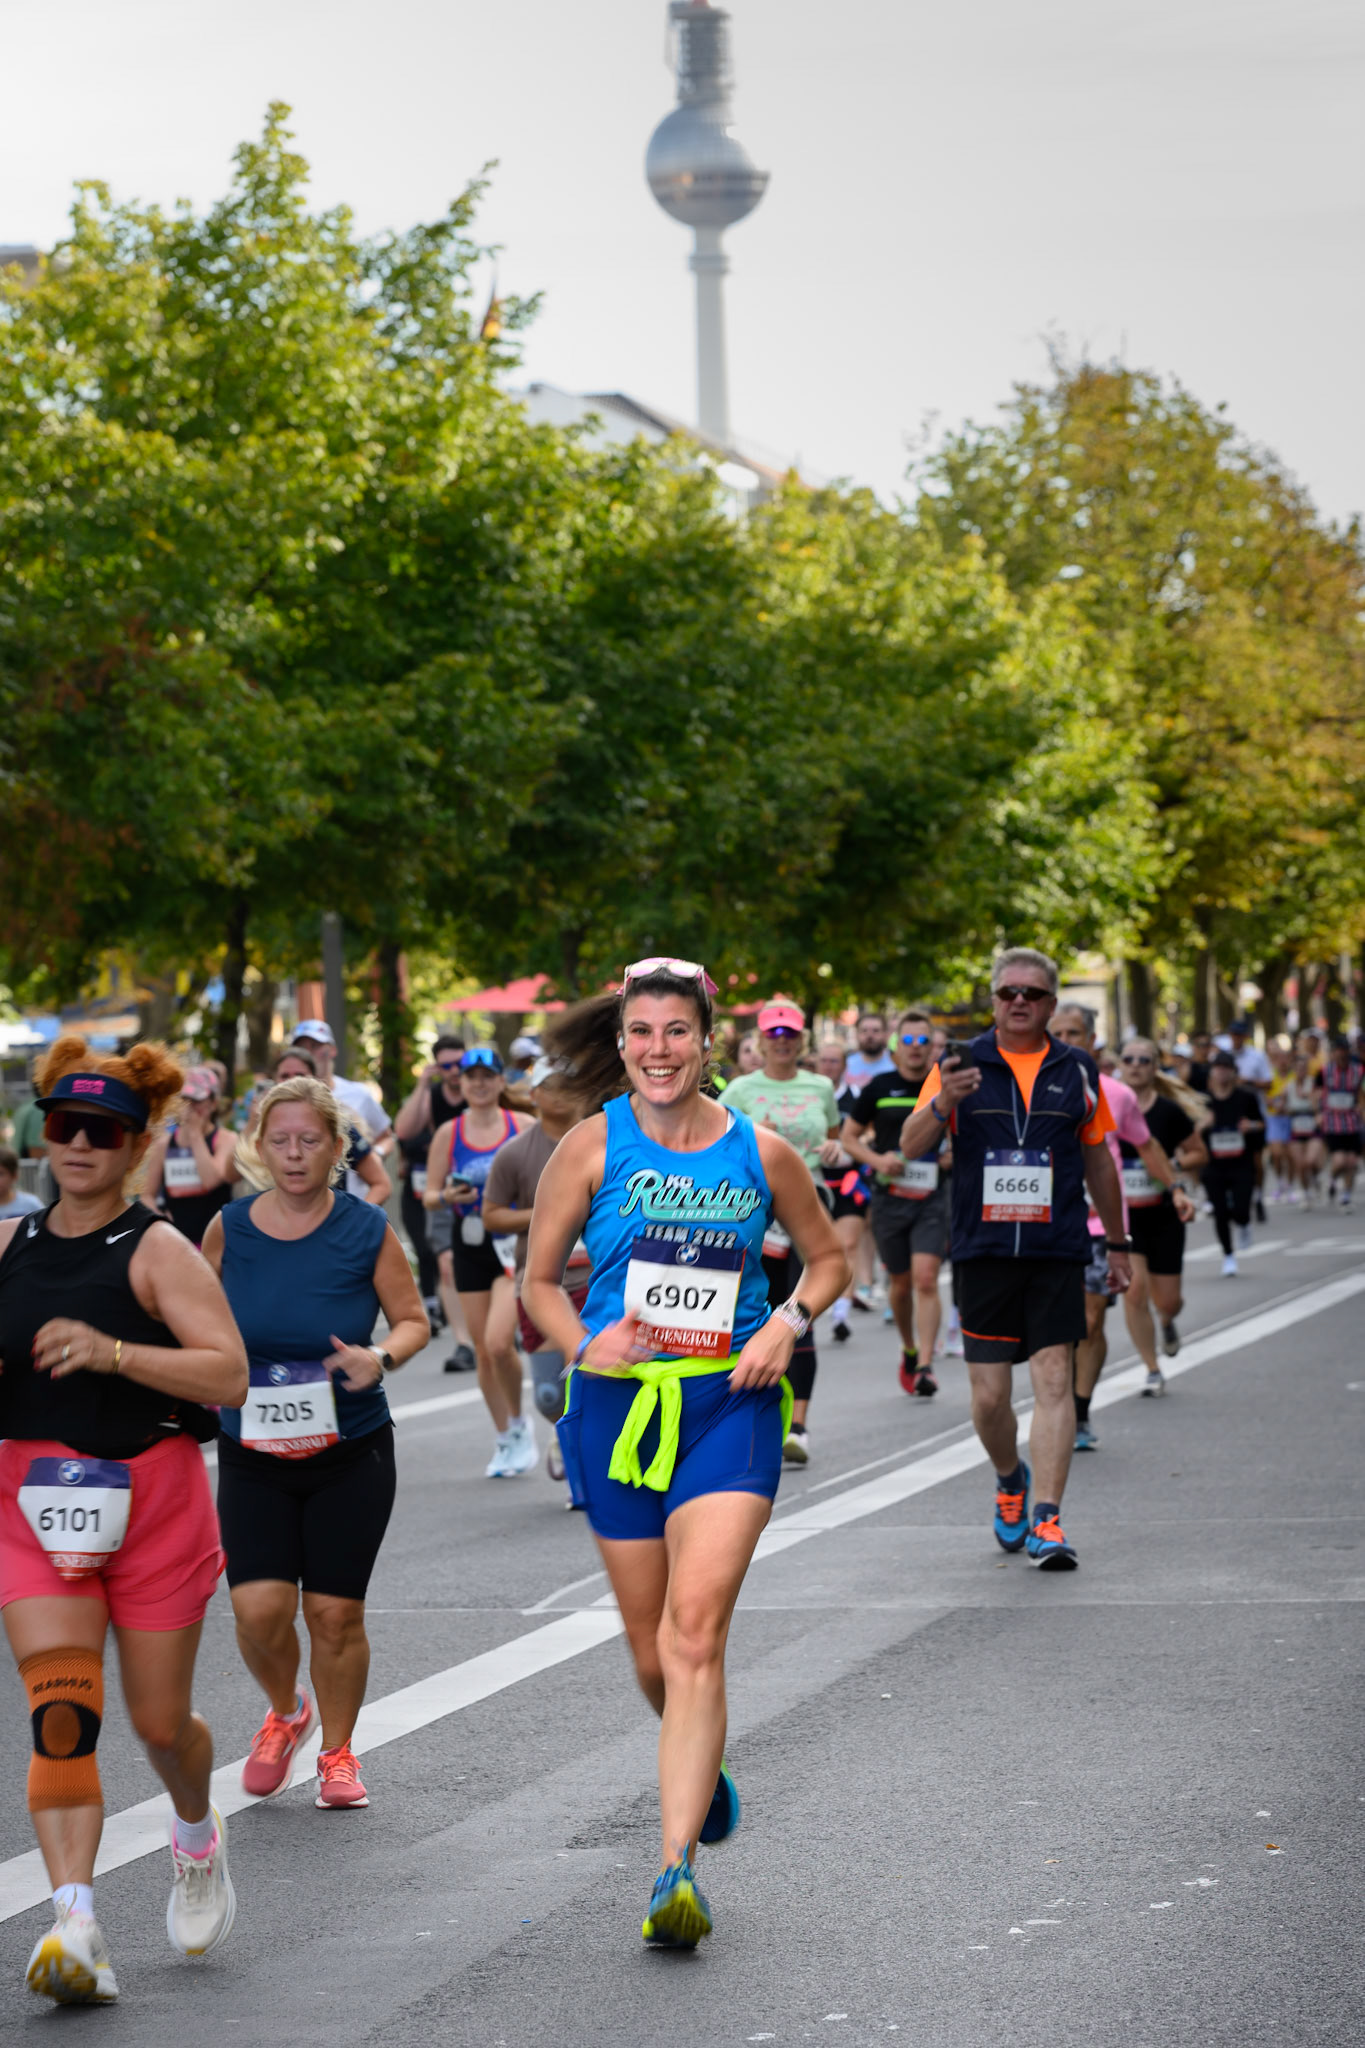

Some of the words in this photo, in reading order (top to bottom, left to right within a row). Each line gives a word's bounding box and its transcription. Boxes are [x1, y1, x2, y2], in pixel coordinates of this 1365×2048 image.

[619, 1168, 761, 1219] Running
[665, 1174, 694, 1189] KC
[994, 1178, 1040, 1193] 6666
[671, 1209, 724, 1219] COMPANY
[645, 1224, 690, 1243] TEAM
[692, 1228, 738, 1249] 2022
[645, 1284, 718, 1312] 6907
[256, 1401, 314, 1424] 7205
[39, 1507, 101, 1533] 6101
